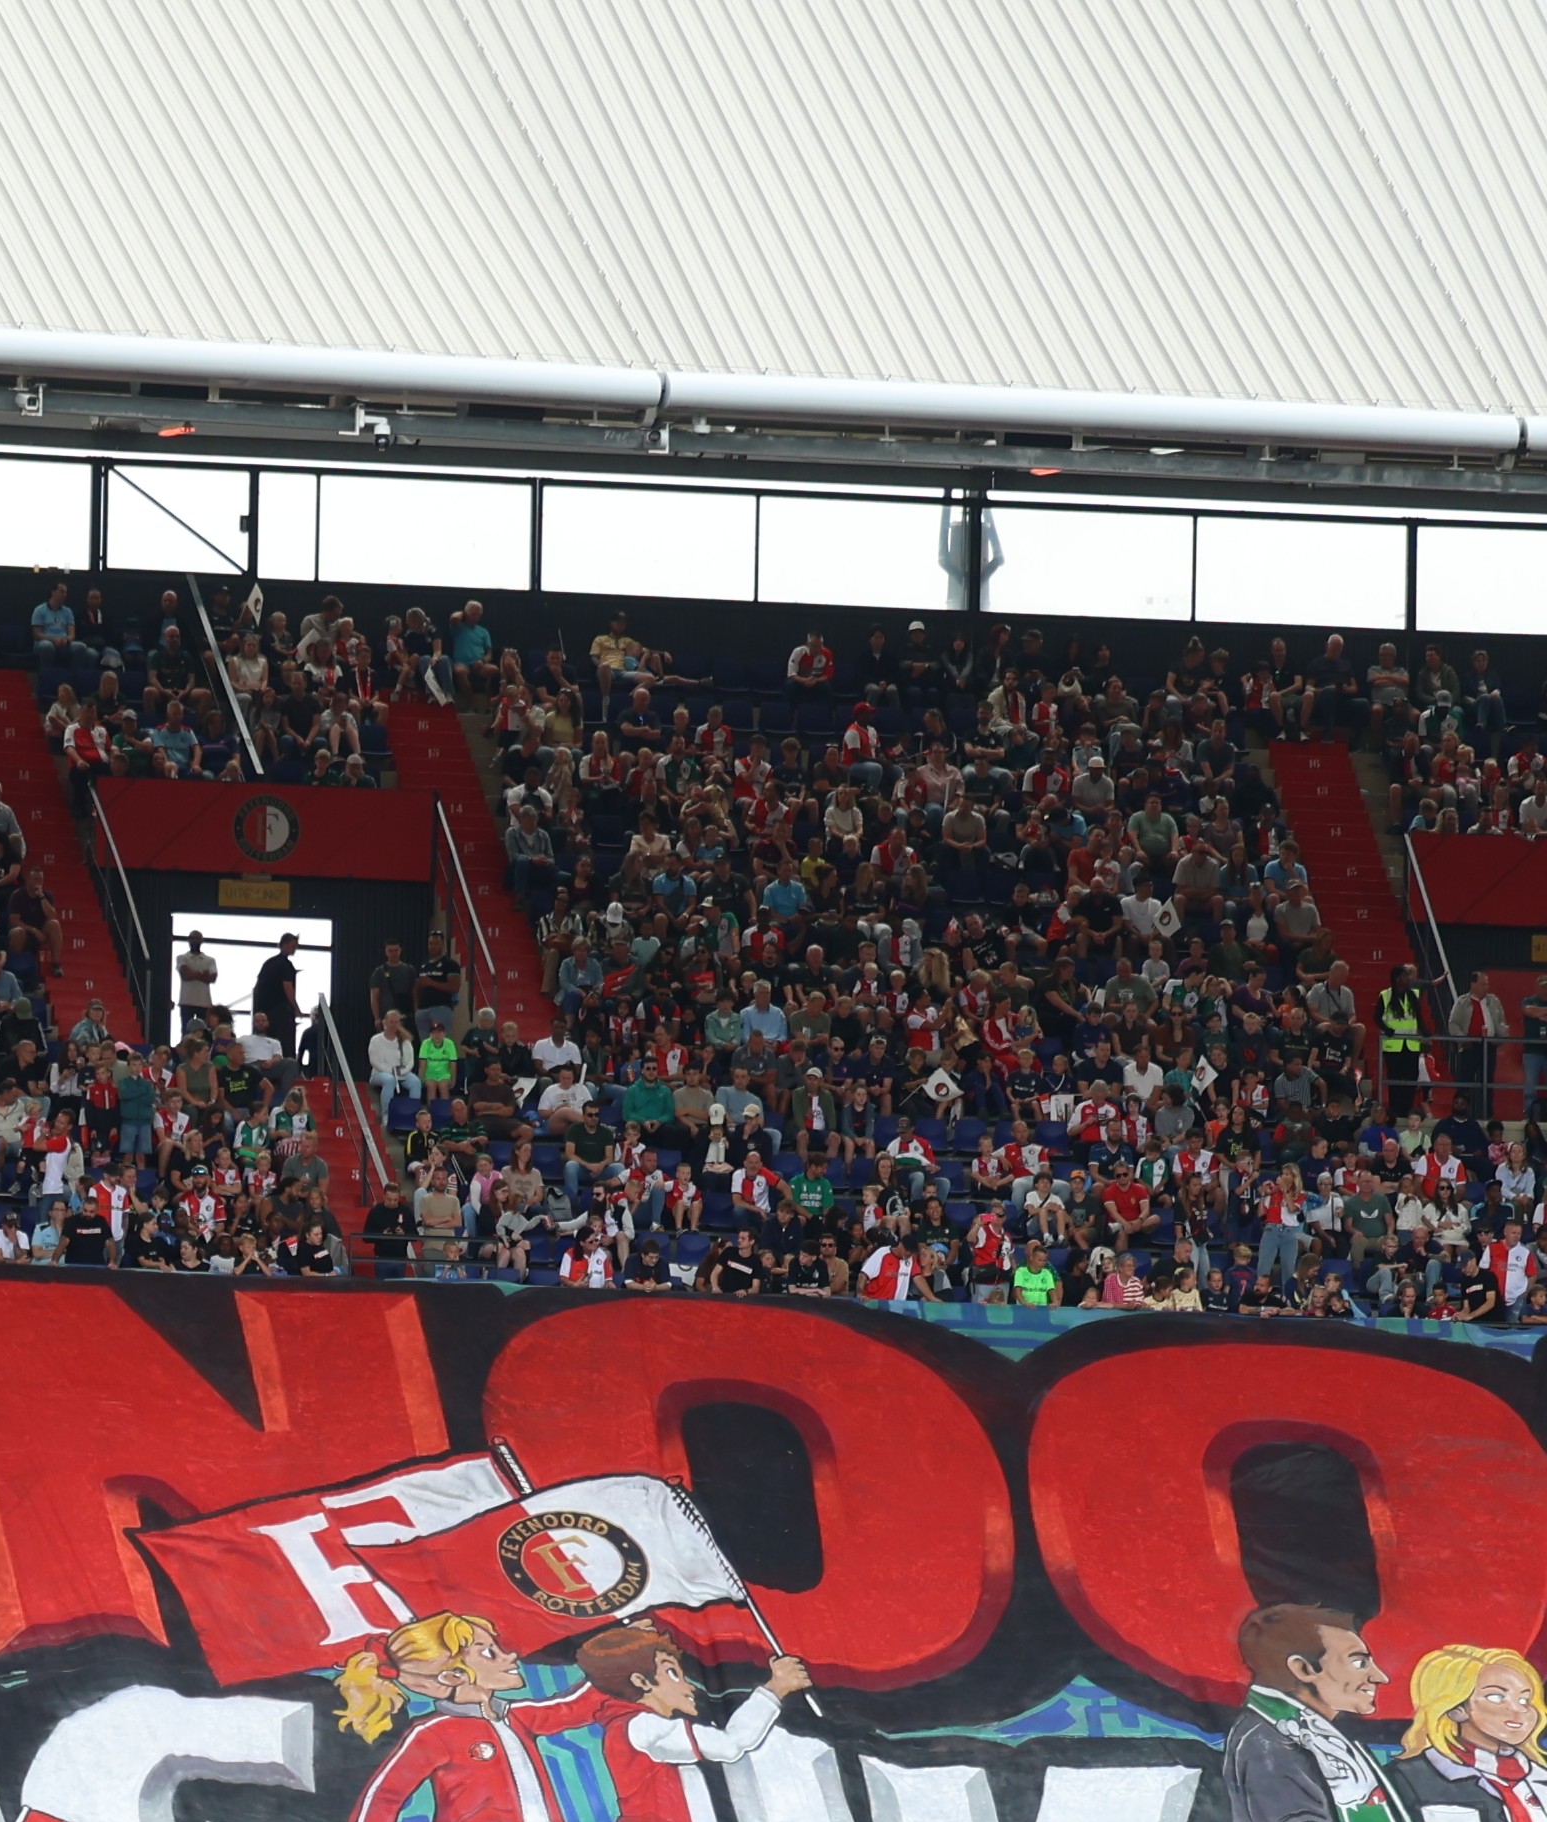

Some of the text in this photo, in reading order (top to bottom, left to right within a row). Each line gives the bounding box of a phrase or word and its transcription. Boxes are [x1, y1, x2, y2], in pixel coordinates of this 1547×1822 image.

[250, 1456, 512, 1646] F
[498, 1511, 611, 1562] FEYENOORD
[530, 1536, 595, 1594] F
[532, 1558, 641, 1617] ROTTERDAM
